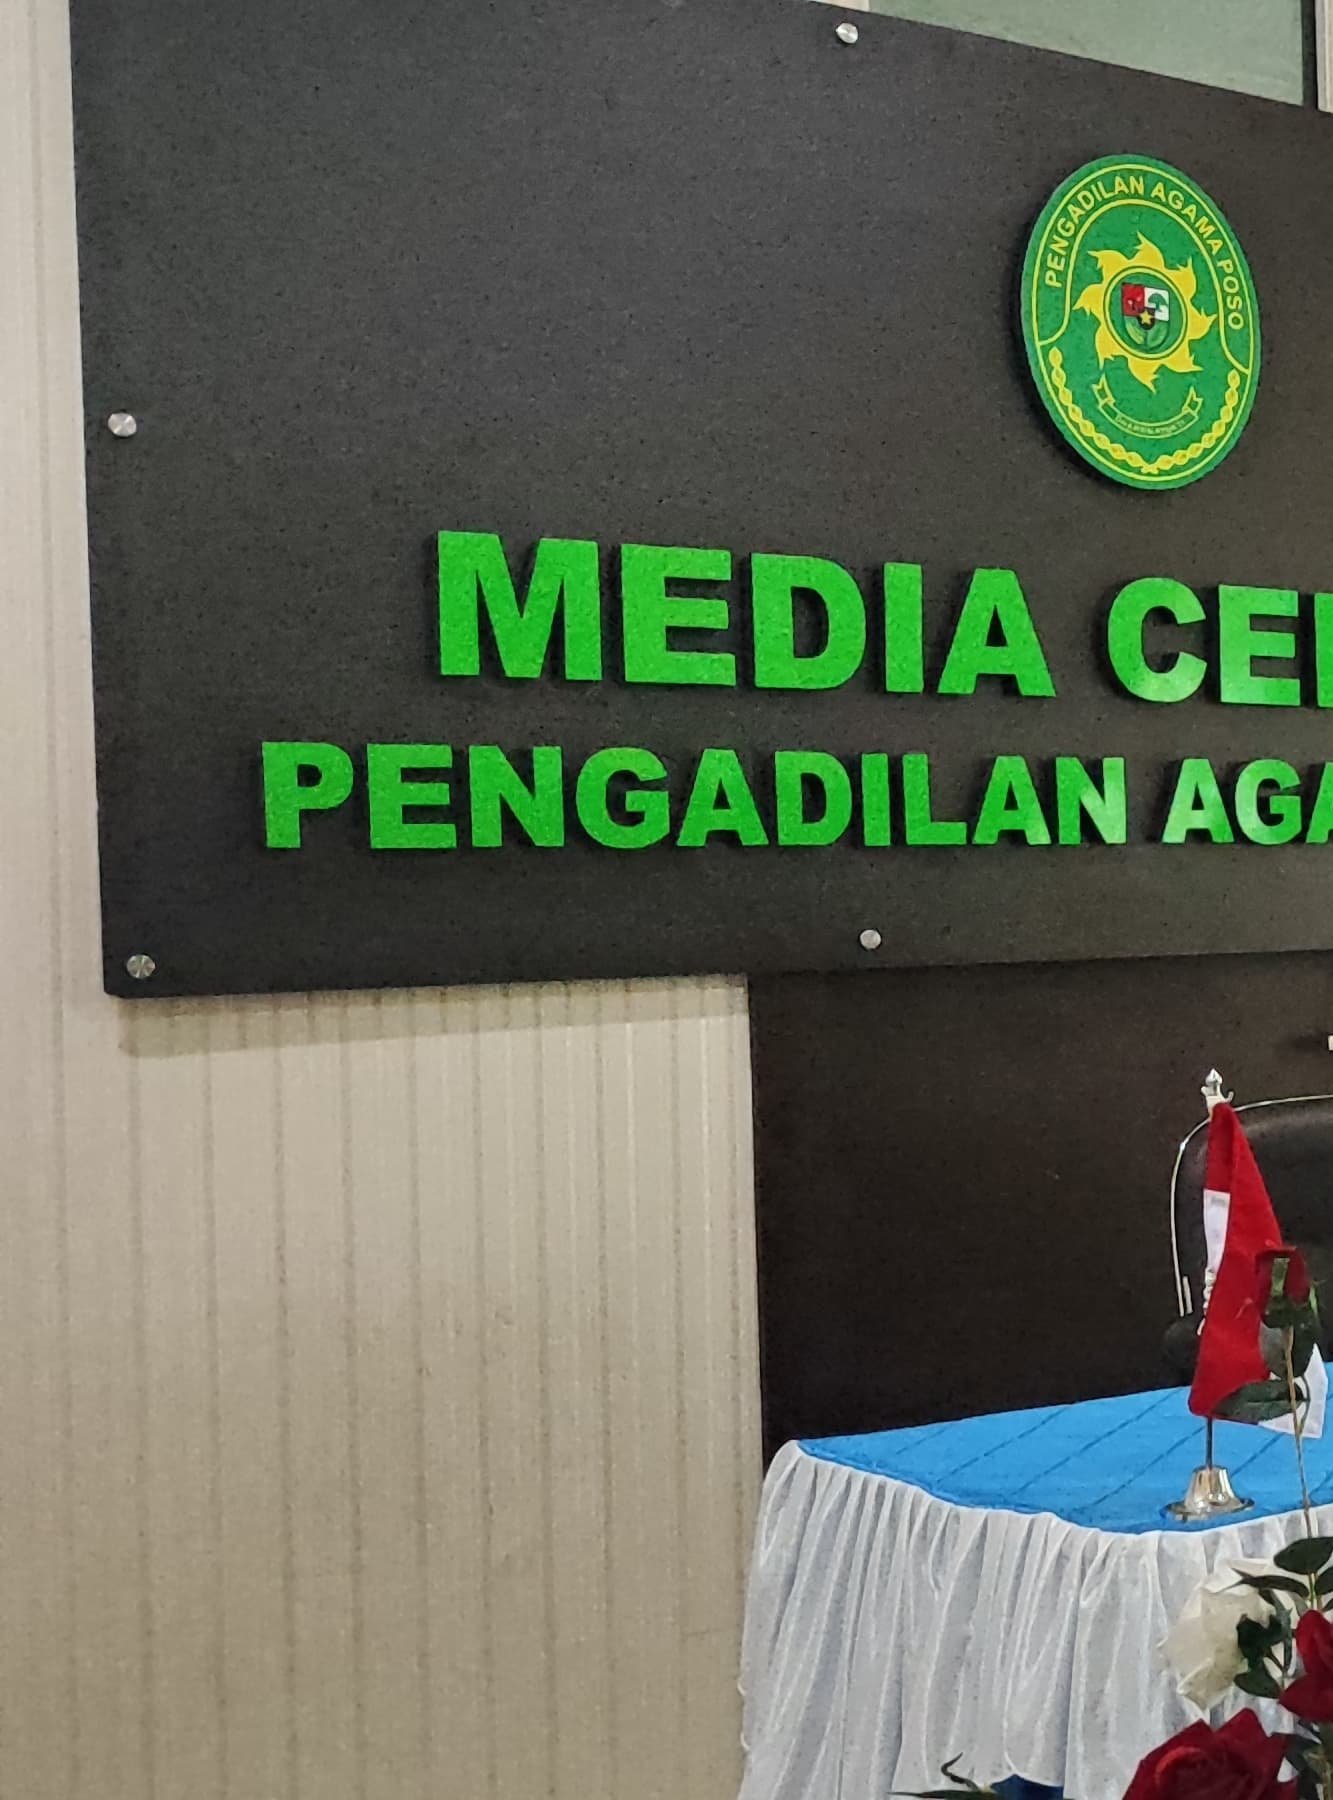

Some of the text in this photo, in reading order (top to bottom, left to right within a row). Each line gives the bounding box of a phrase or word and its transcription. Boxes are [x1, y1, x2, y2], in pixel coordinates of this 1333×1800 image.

[1045, 175, 1244, 330] PENGADILAN AGAMA POSO
[437, 530, 1056, 695] MEDIA
[261, 741, 1126, 849] PENGADILAN
